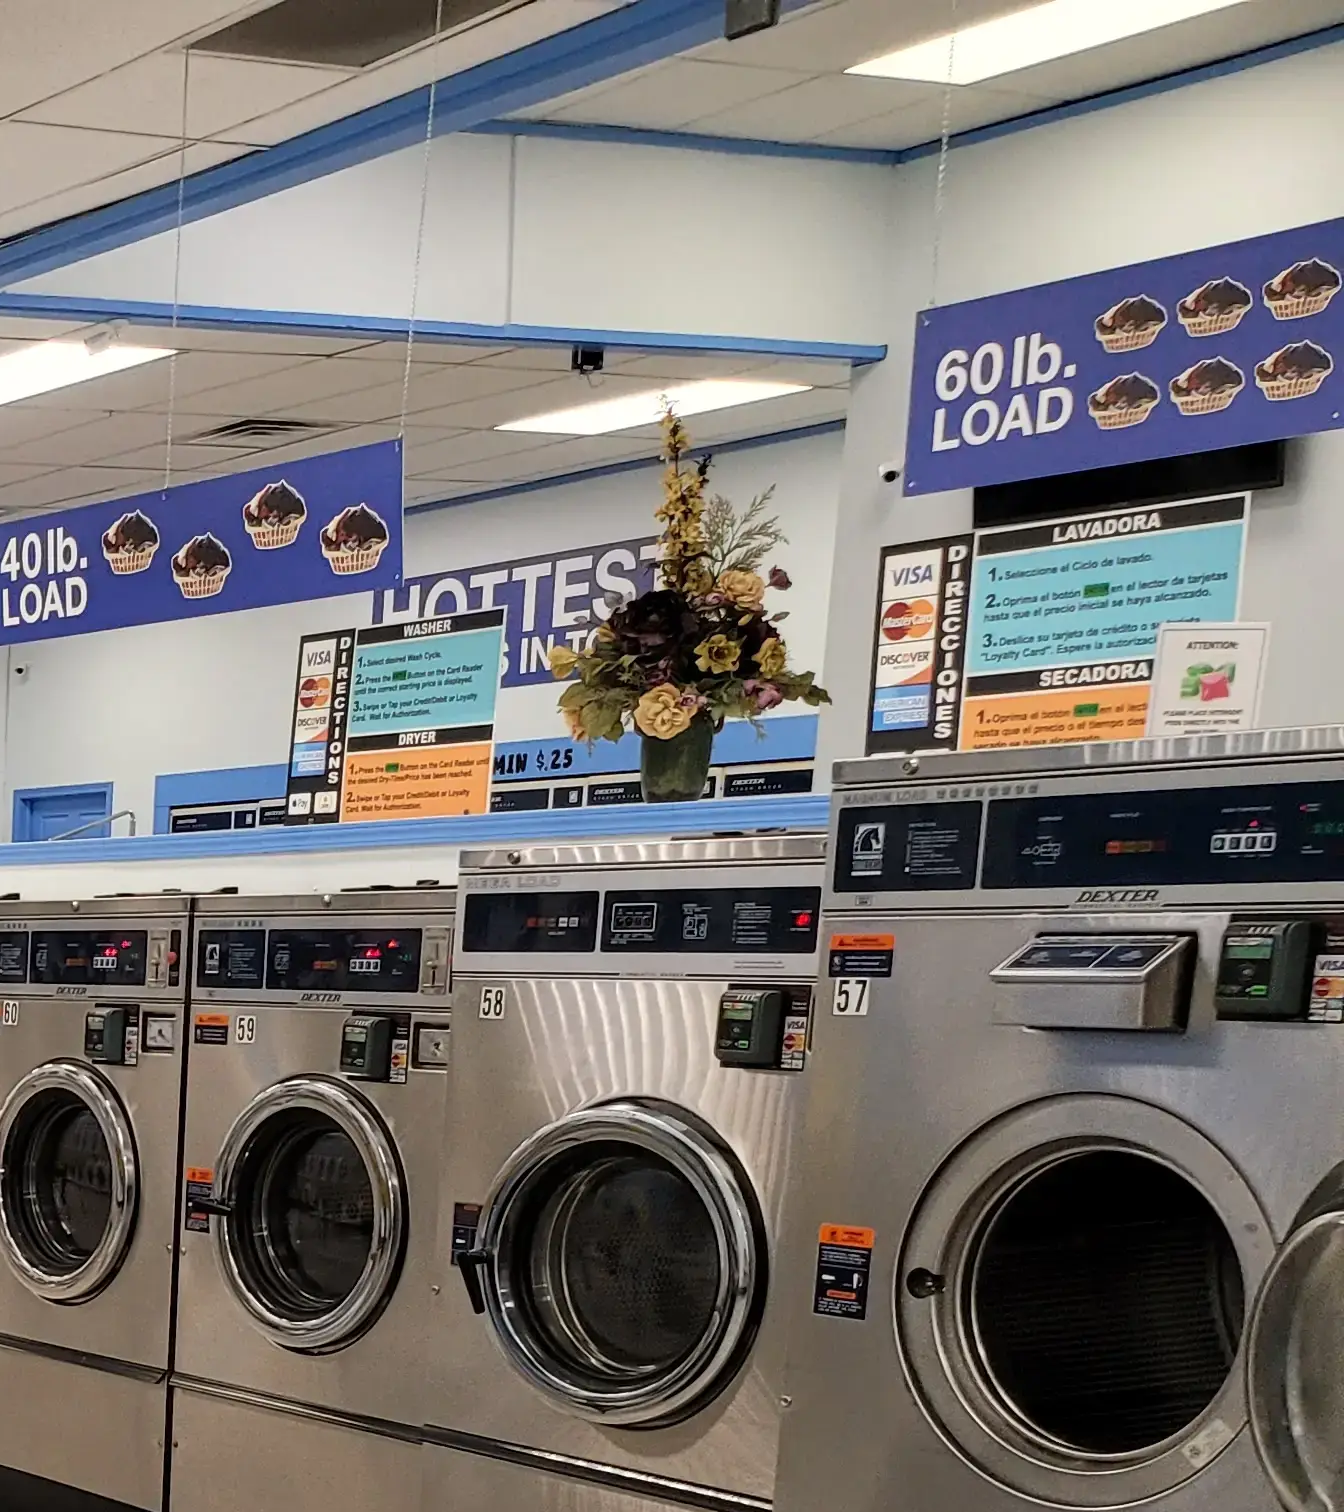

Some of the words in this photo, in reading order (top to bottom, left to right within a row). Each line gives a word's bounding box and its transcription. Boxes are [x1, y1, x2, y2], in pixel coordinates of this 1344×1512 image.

[935, 342, 1004, 401] 60
[1011, 333, 1076, 388] lb.
[932, 387, 1074, 452] LOAD
[1052, 512, 1161, 543] LAVADORA
[0, 533, 41, 581] 40
[48, 527, 87, 575] lb.
[890, 564, 933, 586] VISA
[988, 568, 1003, 582] 1.
[1101, 558, 1114, 567] de
[380, 546, 662, 634] HOTTES
[985, 594, 1000, 608] 2.
[1003, 596, 1038, 607] Oprima
[1138, 579, 1169, 590] lector
[1171, 576, 1184, 586] de
[1188, 571, 1228, 585] tarjetas
[3, 577, 87, 627] LOAD
[1012, 610, 1030, 620] que
[1044, 605, 1076, 617] precio
[1127, 596, 1151, 606] haya
[403, 619, 452, 638] WASHER
[982, 633, 997, 648] 3.
[1052, 630, 1083, 641] tarjeta
[1086, 627, 1098, 636] de
[933, 546, 968, 739] DIRECCIONES
[307, 650, 331, 667] VISA
[880, 651, 930, 666] DISCOVER
[1039, 662, 1150, 687] SECADORA
[298, 716, 327, 727] DISCOVER
[328, 637, 351, 784] DIRECTIONS
[976, 710, 991, 724] 1.
[398, 731, 436, 746] DRYER
[493, 753, 528, 775] MIN
[536, 749, 573, 771] $.25
[1074, 890, 1160, 903] DEXTER
[56, 987, 87, 995] DEXTER
[300, 994, 341, 1002] DEXTER
[482, 989, 503, 1016] 58
[836, 980, 867, 1012] 57
[4, 1002, 18, 1023] 60
[237, 1017, 255, 1041] 59
[787, 1021, 805, 1029] VISA
